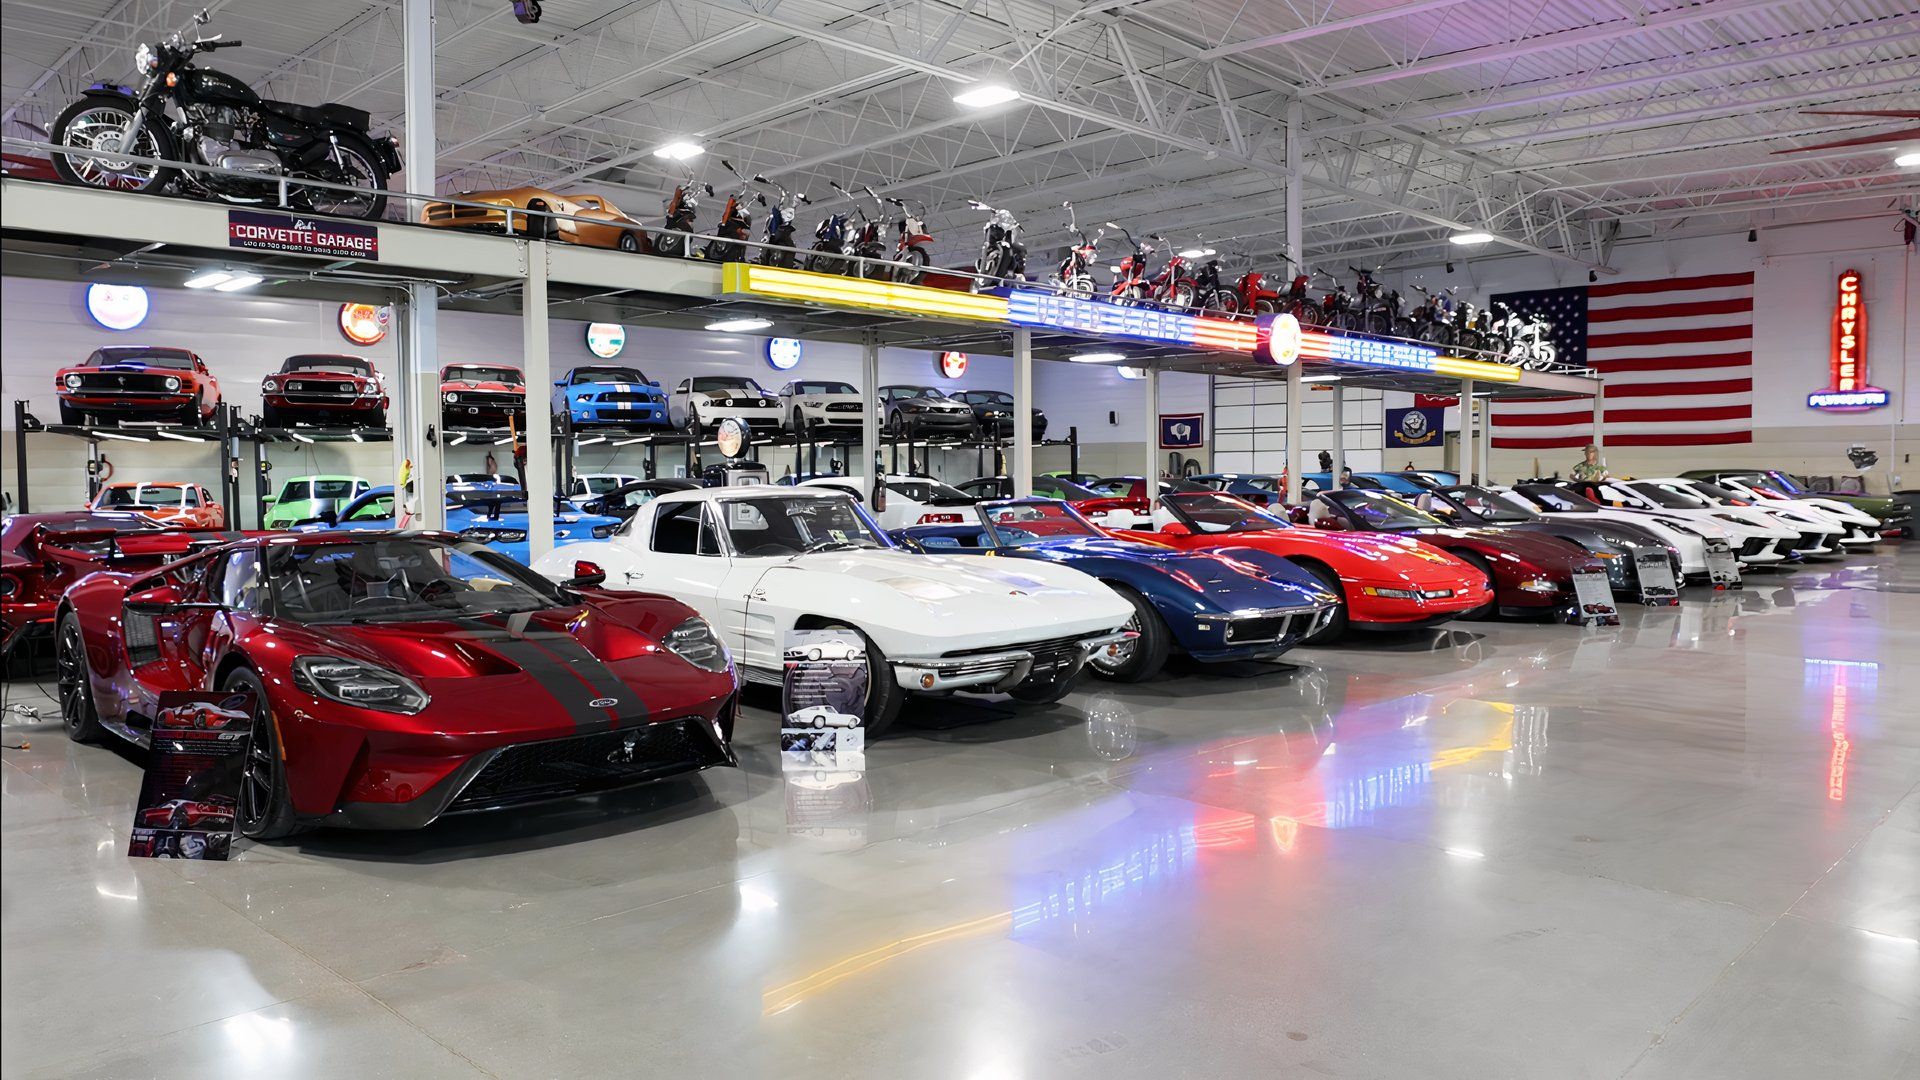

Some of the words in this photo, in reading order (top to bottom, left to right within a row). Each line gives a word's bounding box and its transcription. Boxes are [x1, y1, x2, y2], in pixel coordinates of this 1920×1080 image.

[236, 225, 313, 244] CORVETTE
[317, 232, 372, 250] GARAGE
[1840, 276, 1858, 391] CHRYSLER
